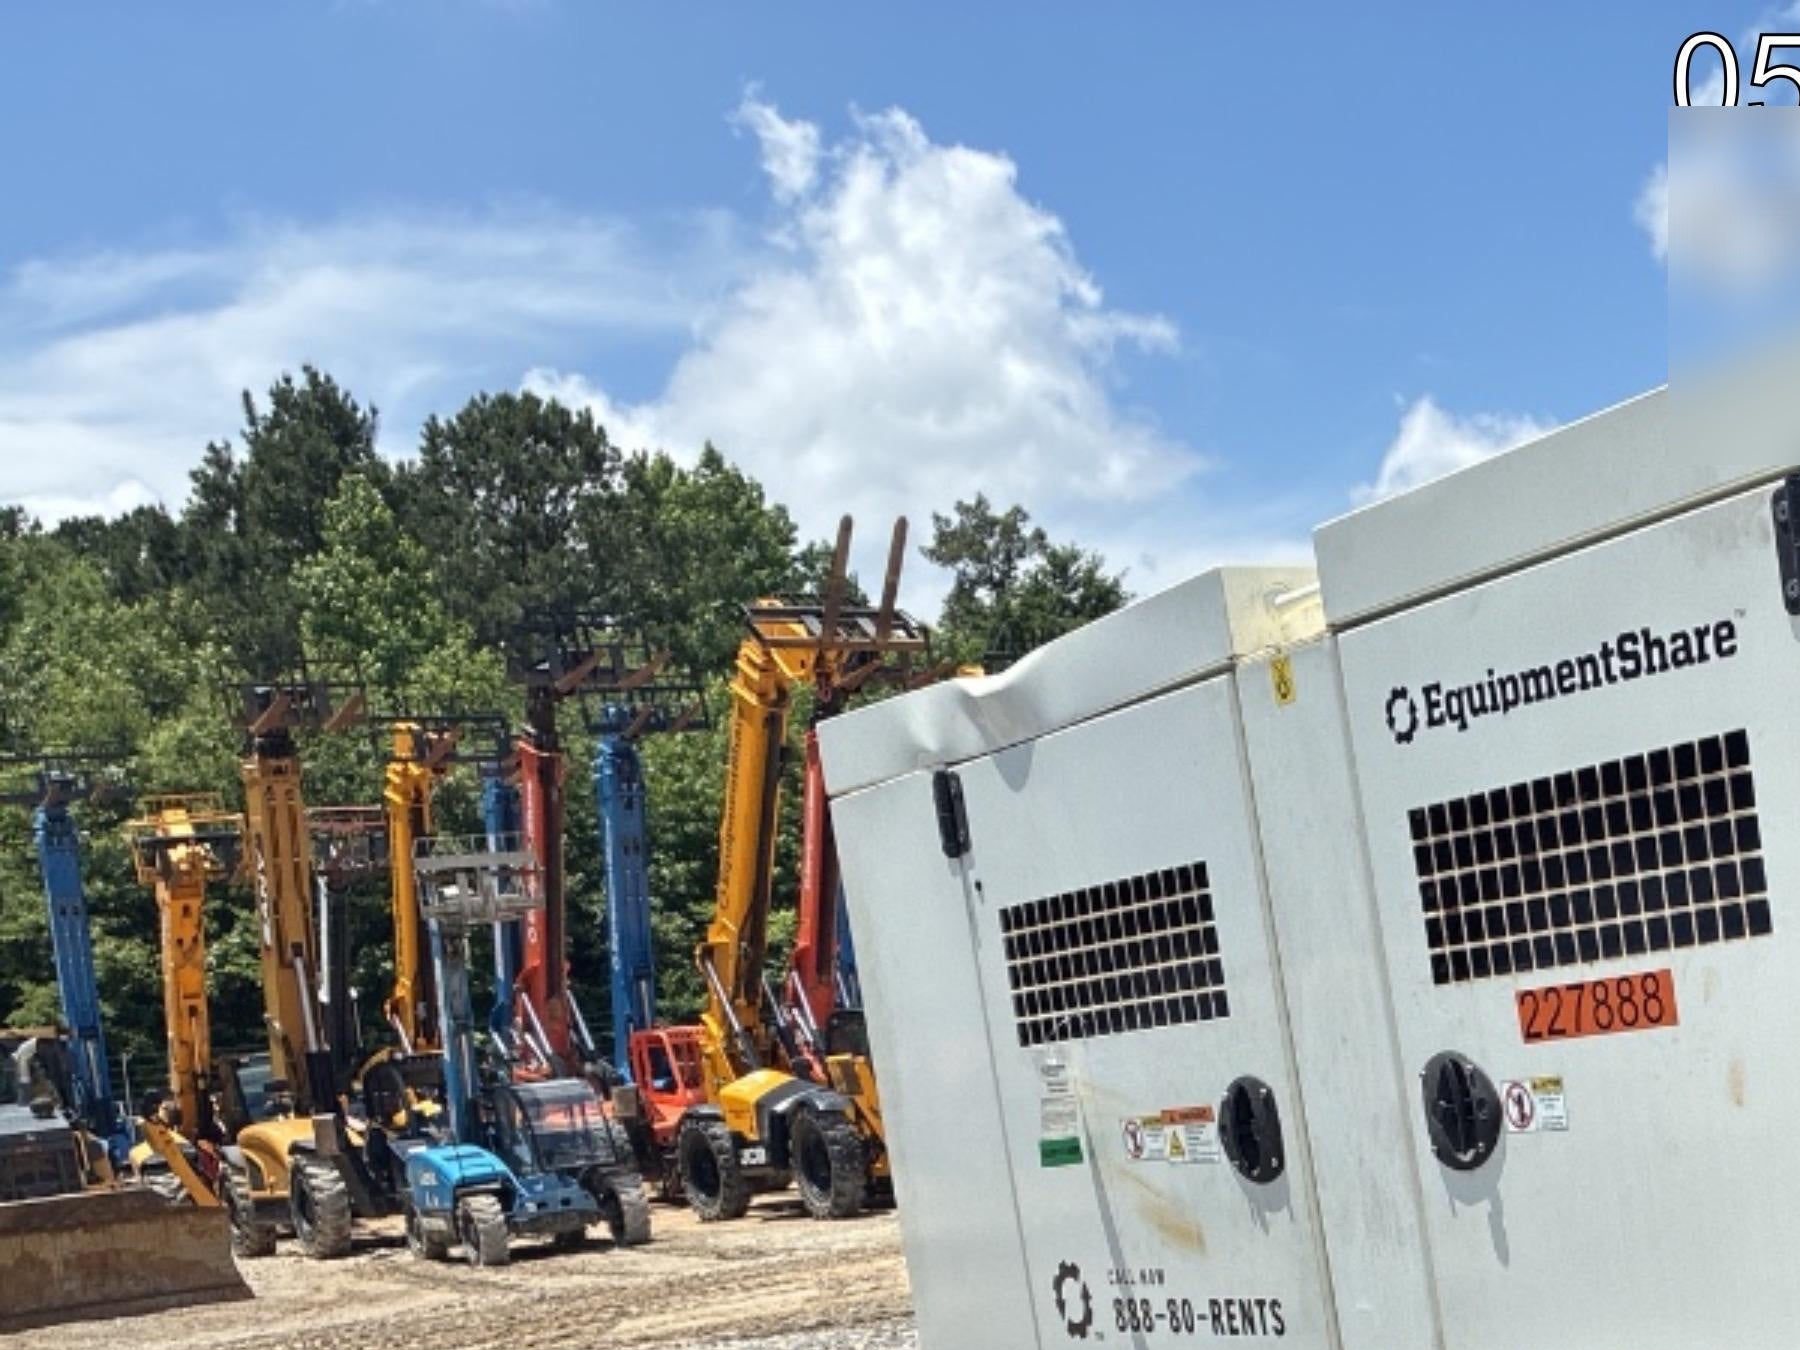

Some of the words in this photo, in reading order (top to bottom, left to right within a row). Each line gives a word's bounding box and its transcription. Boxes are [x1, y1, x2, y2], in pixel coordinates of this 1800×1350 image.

[1422, 617, 1738, 733] EquipmentShare
[1519, 972, 1666, 1039] 227888
[1112, 1297, 1286, 1337] 888-80-RENTS
